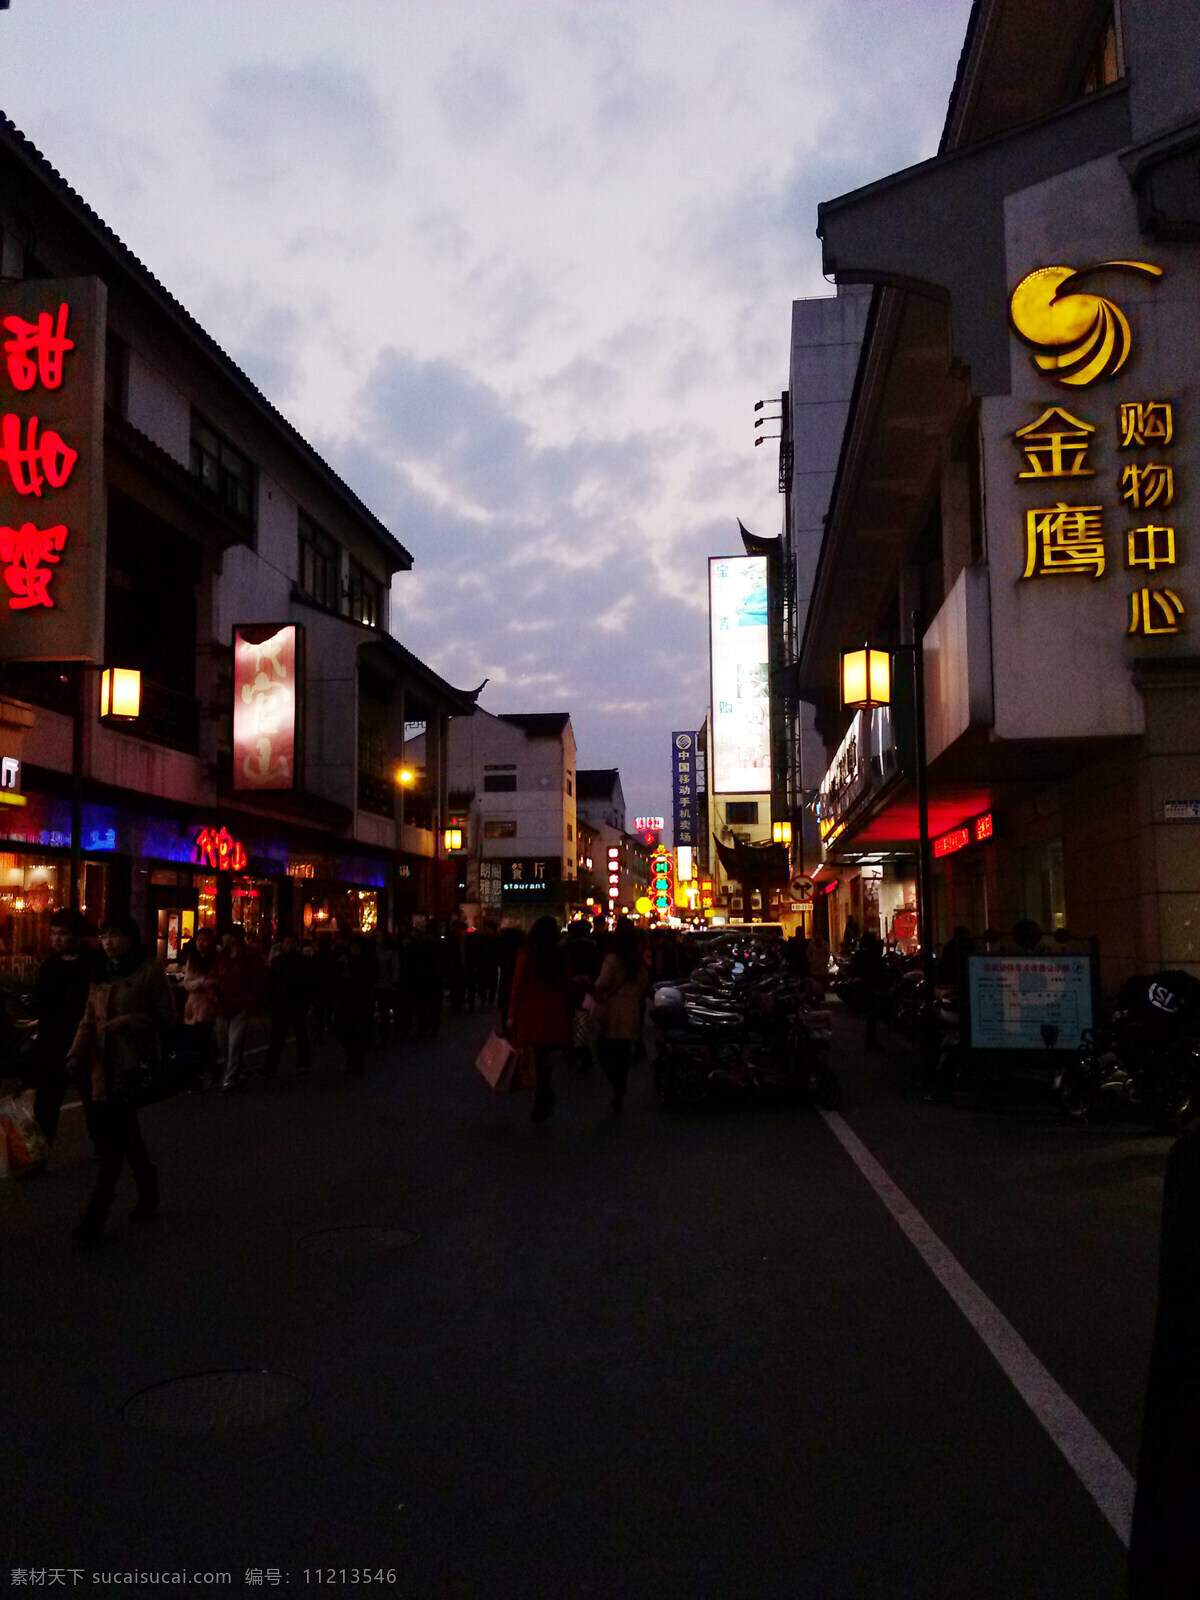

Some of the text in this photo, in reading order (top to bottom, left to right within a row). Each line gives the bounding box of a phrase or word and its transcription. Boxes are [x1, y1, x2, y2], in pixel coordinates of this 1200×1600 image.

[1015, 406, 1106, 580] 金鹰
[1120, 401, 1186, 636] 购物中心
[677, 750, 692, 842] 中国移动手机卖场
